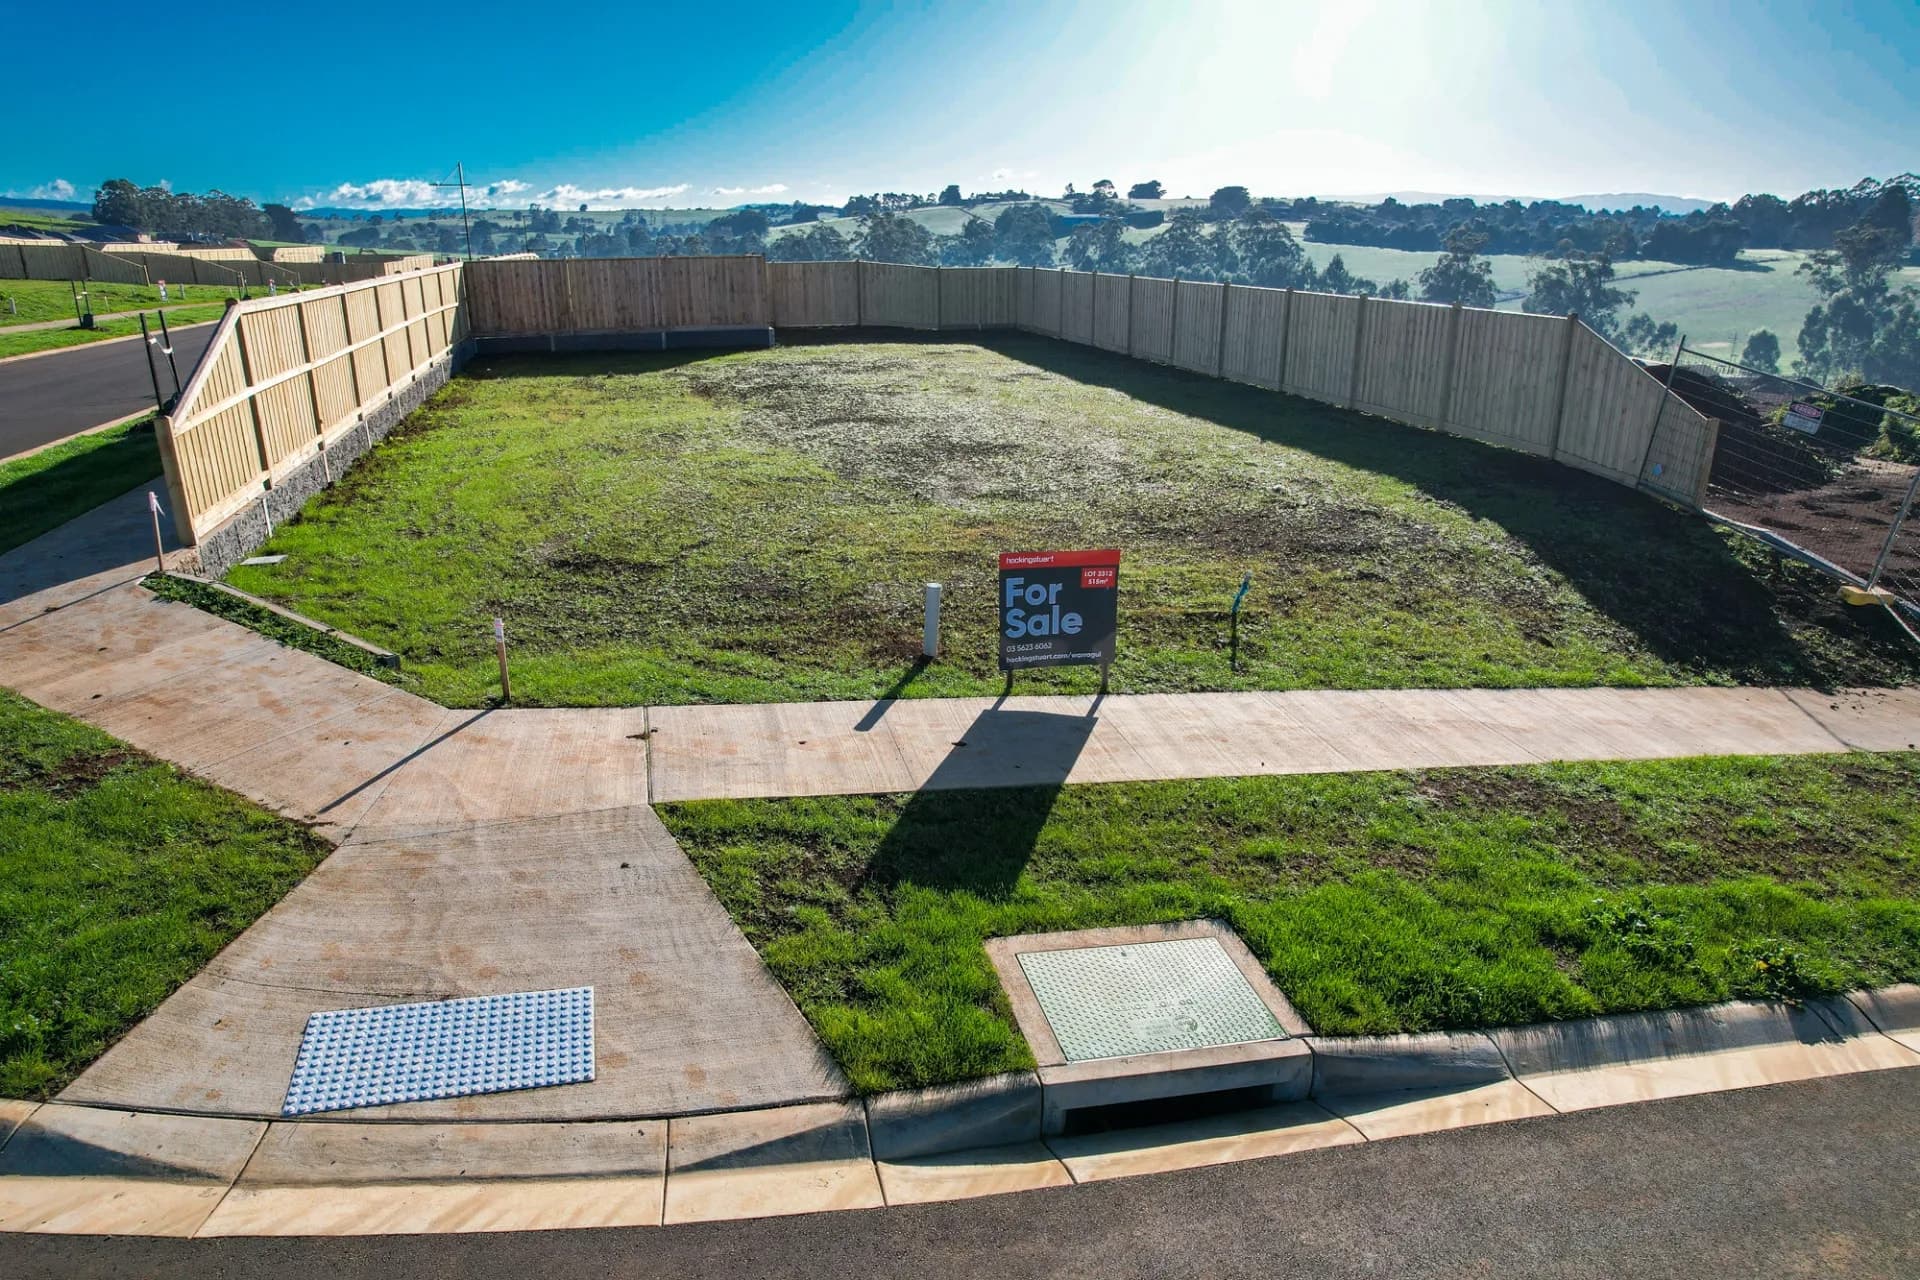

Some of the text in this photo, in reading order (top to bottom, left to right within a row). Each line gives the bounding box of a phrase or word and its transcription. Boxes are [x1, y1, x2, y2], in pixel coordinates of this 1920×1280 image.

[1006, 556, 1054, 564] hockingstuart
[1006, 577, 1063, 608] For
[1005, 605, 1083, 638] Sale
[1006, 641, 1053, 653] 03 5623 6062
